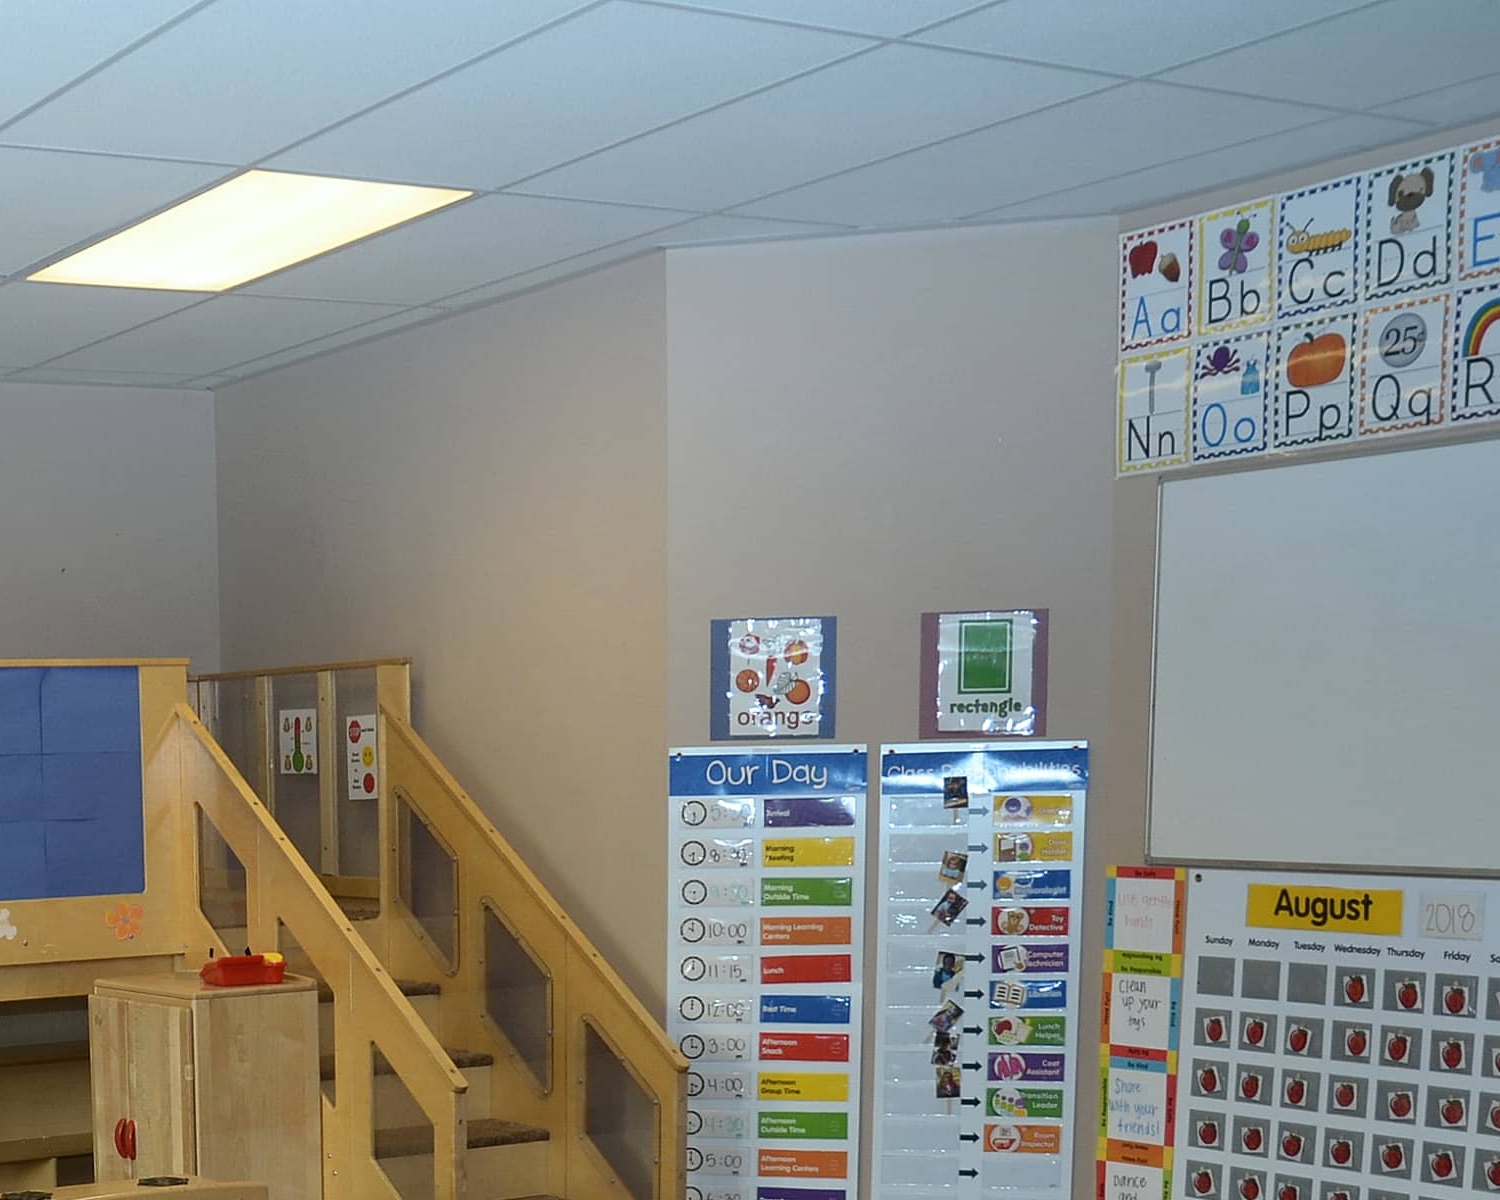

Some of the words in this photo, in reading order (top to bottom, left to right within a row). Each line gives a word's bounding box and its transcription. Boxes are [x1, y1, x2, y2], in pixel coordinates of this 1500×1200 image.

[1377, 236, 1438, 287] Dd
[1288, 258, 1346, 304] Cc
[1208, 278, 1261, 324] Bb
[1131, 296, 1182, 341] Aa
[1372, 374, 1433, 425] Qq
[1201, 402, 1256, 447] Oo
[1284, 390, 1342, 440] Pp
[1127, 416, 1176, 462] Nn
[949, 698, 1022, 718] rectangle
[737, 709, 814, 730] orange
[706, 759, 760, 785] Our
[771, 759, 828, 789] Day
[1274, 888, 1373, 927] August
[1028, 924, 1064, 932] Detective
[1426, 903, 1476, 934] 2018
[708, 922, 748, 938] 10:00
[1204, 935, 1234, 948] Sunday
[1247, 937, 1280, 950] Monday
[1293, 940, 1326, 953] Tuesday
[1333, 943, 1382, 957] Wednesday
[1387, 946, 1426, 960] Thursday
[1443, 950, 1472, 963] Friday
[763, 966, 785, 975] Lunch
[1118, 979, 1147, 994] Clean
[1136, 997, 1163, 1014] your
[708, 1037, 746, 1054] 3:00
[762, 1038, 798, 1046] Afternoon
[707, 1077, 743, 1093] 4:00
[761, 1078, 797, 1086] Afternoon
[783, 1087, 802, 1095] Time
[1114, 1077, 1142, 1095] Share
[706, 1153, 742, 1169] 5:00
[1113, 1174, 1148, 1189] Dance
